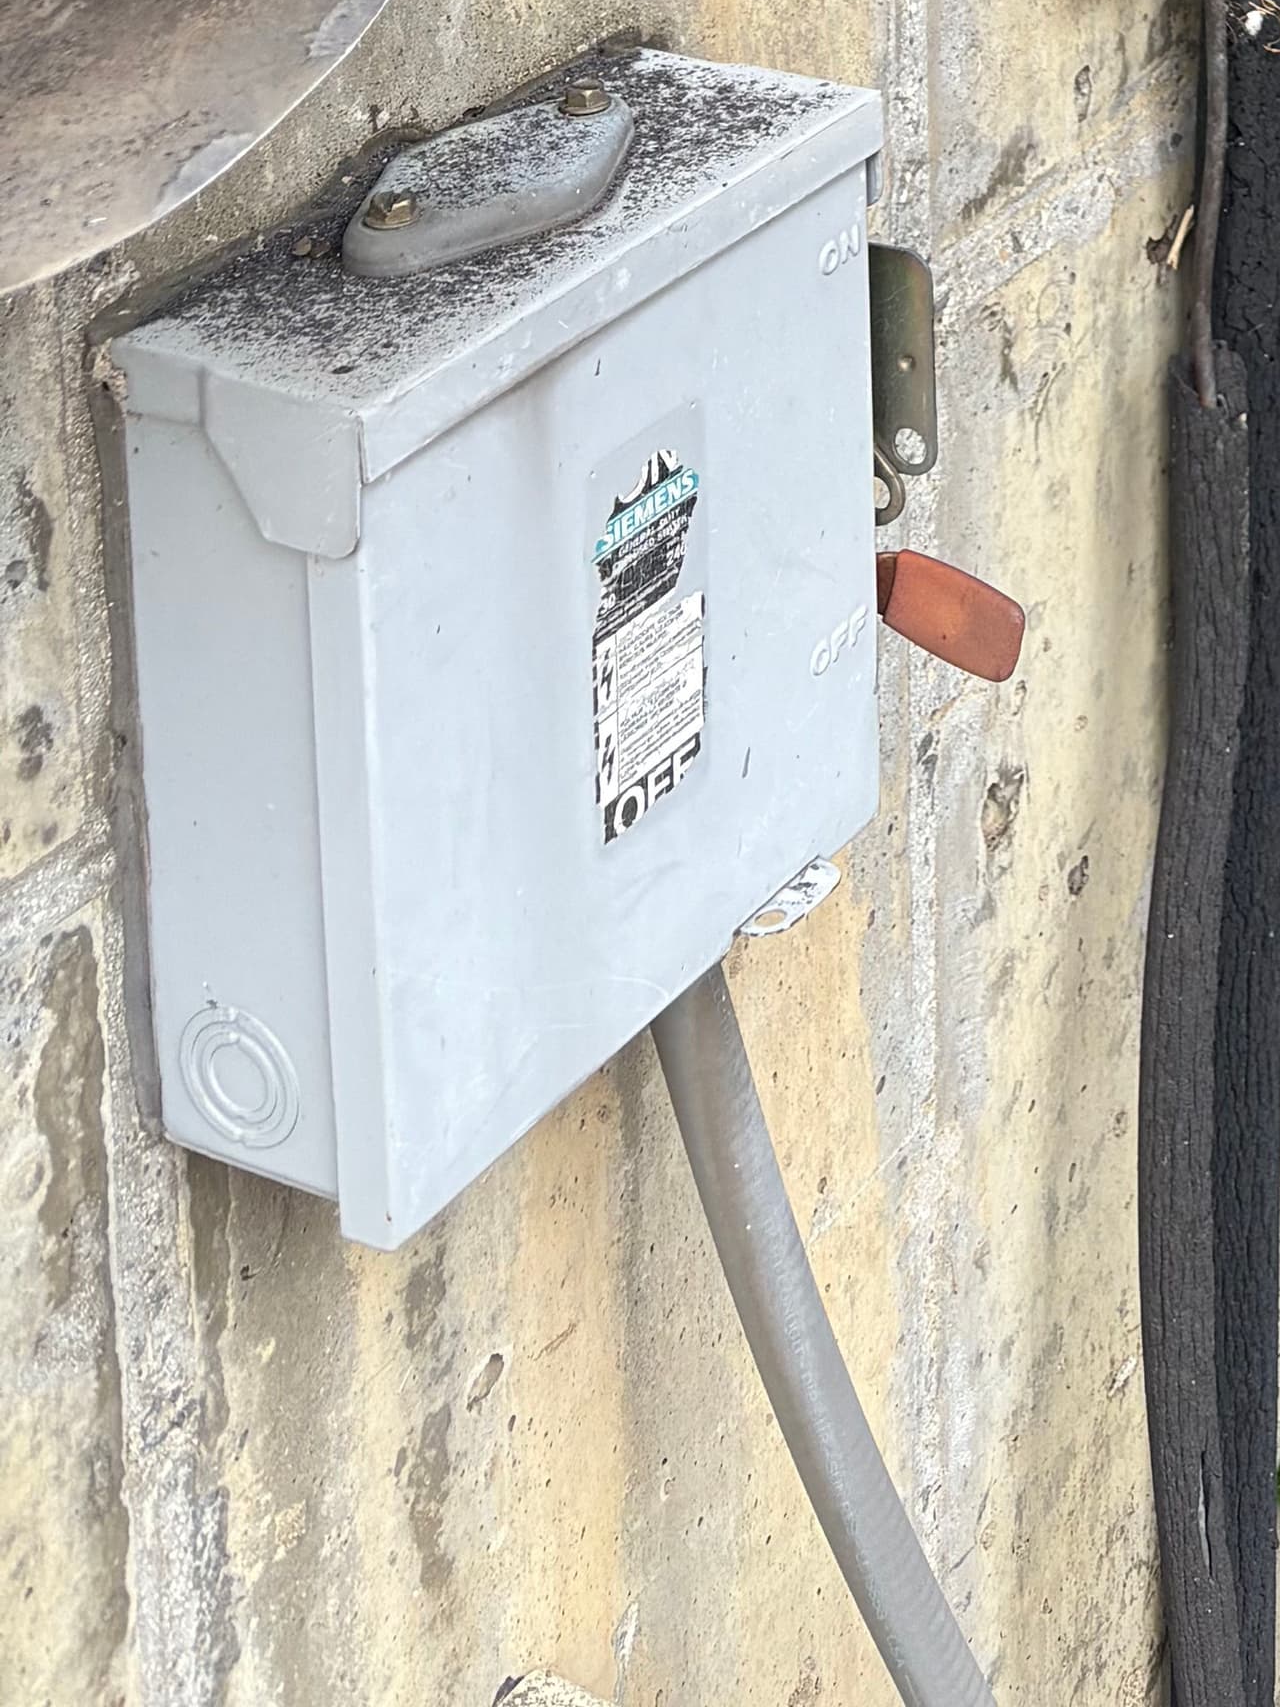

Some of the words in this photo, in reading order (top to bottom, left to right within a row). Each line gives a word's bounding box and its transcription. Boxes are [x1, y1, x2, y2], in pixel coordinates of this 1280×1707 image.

[819, 222, 861, 276] ON
[596, 468, 695, 552] SIEMENS
[809, 604, 868, 677] OFF
[614, 737, 697, 836] OFF
